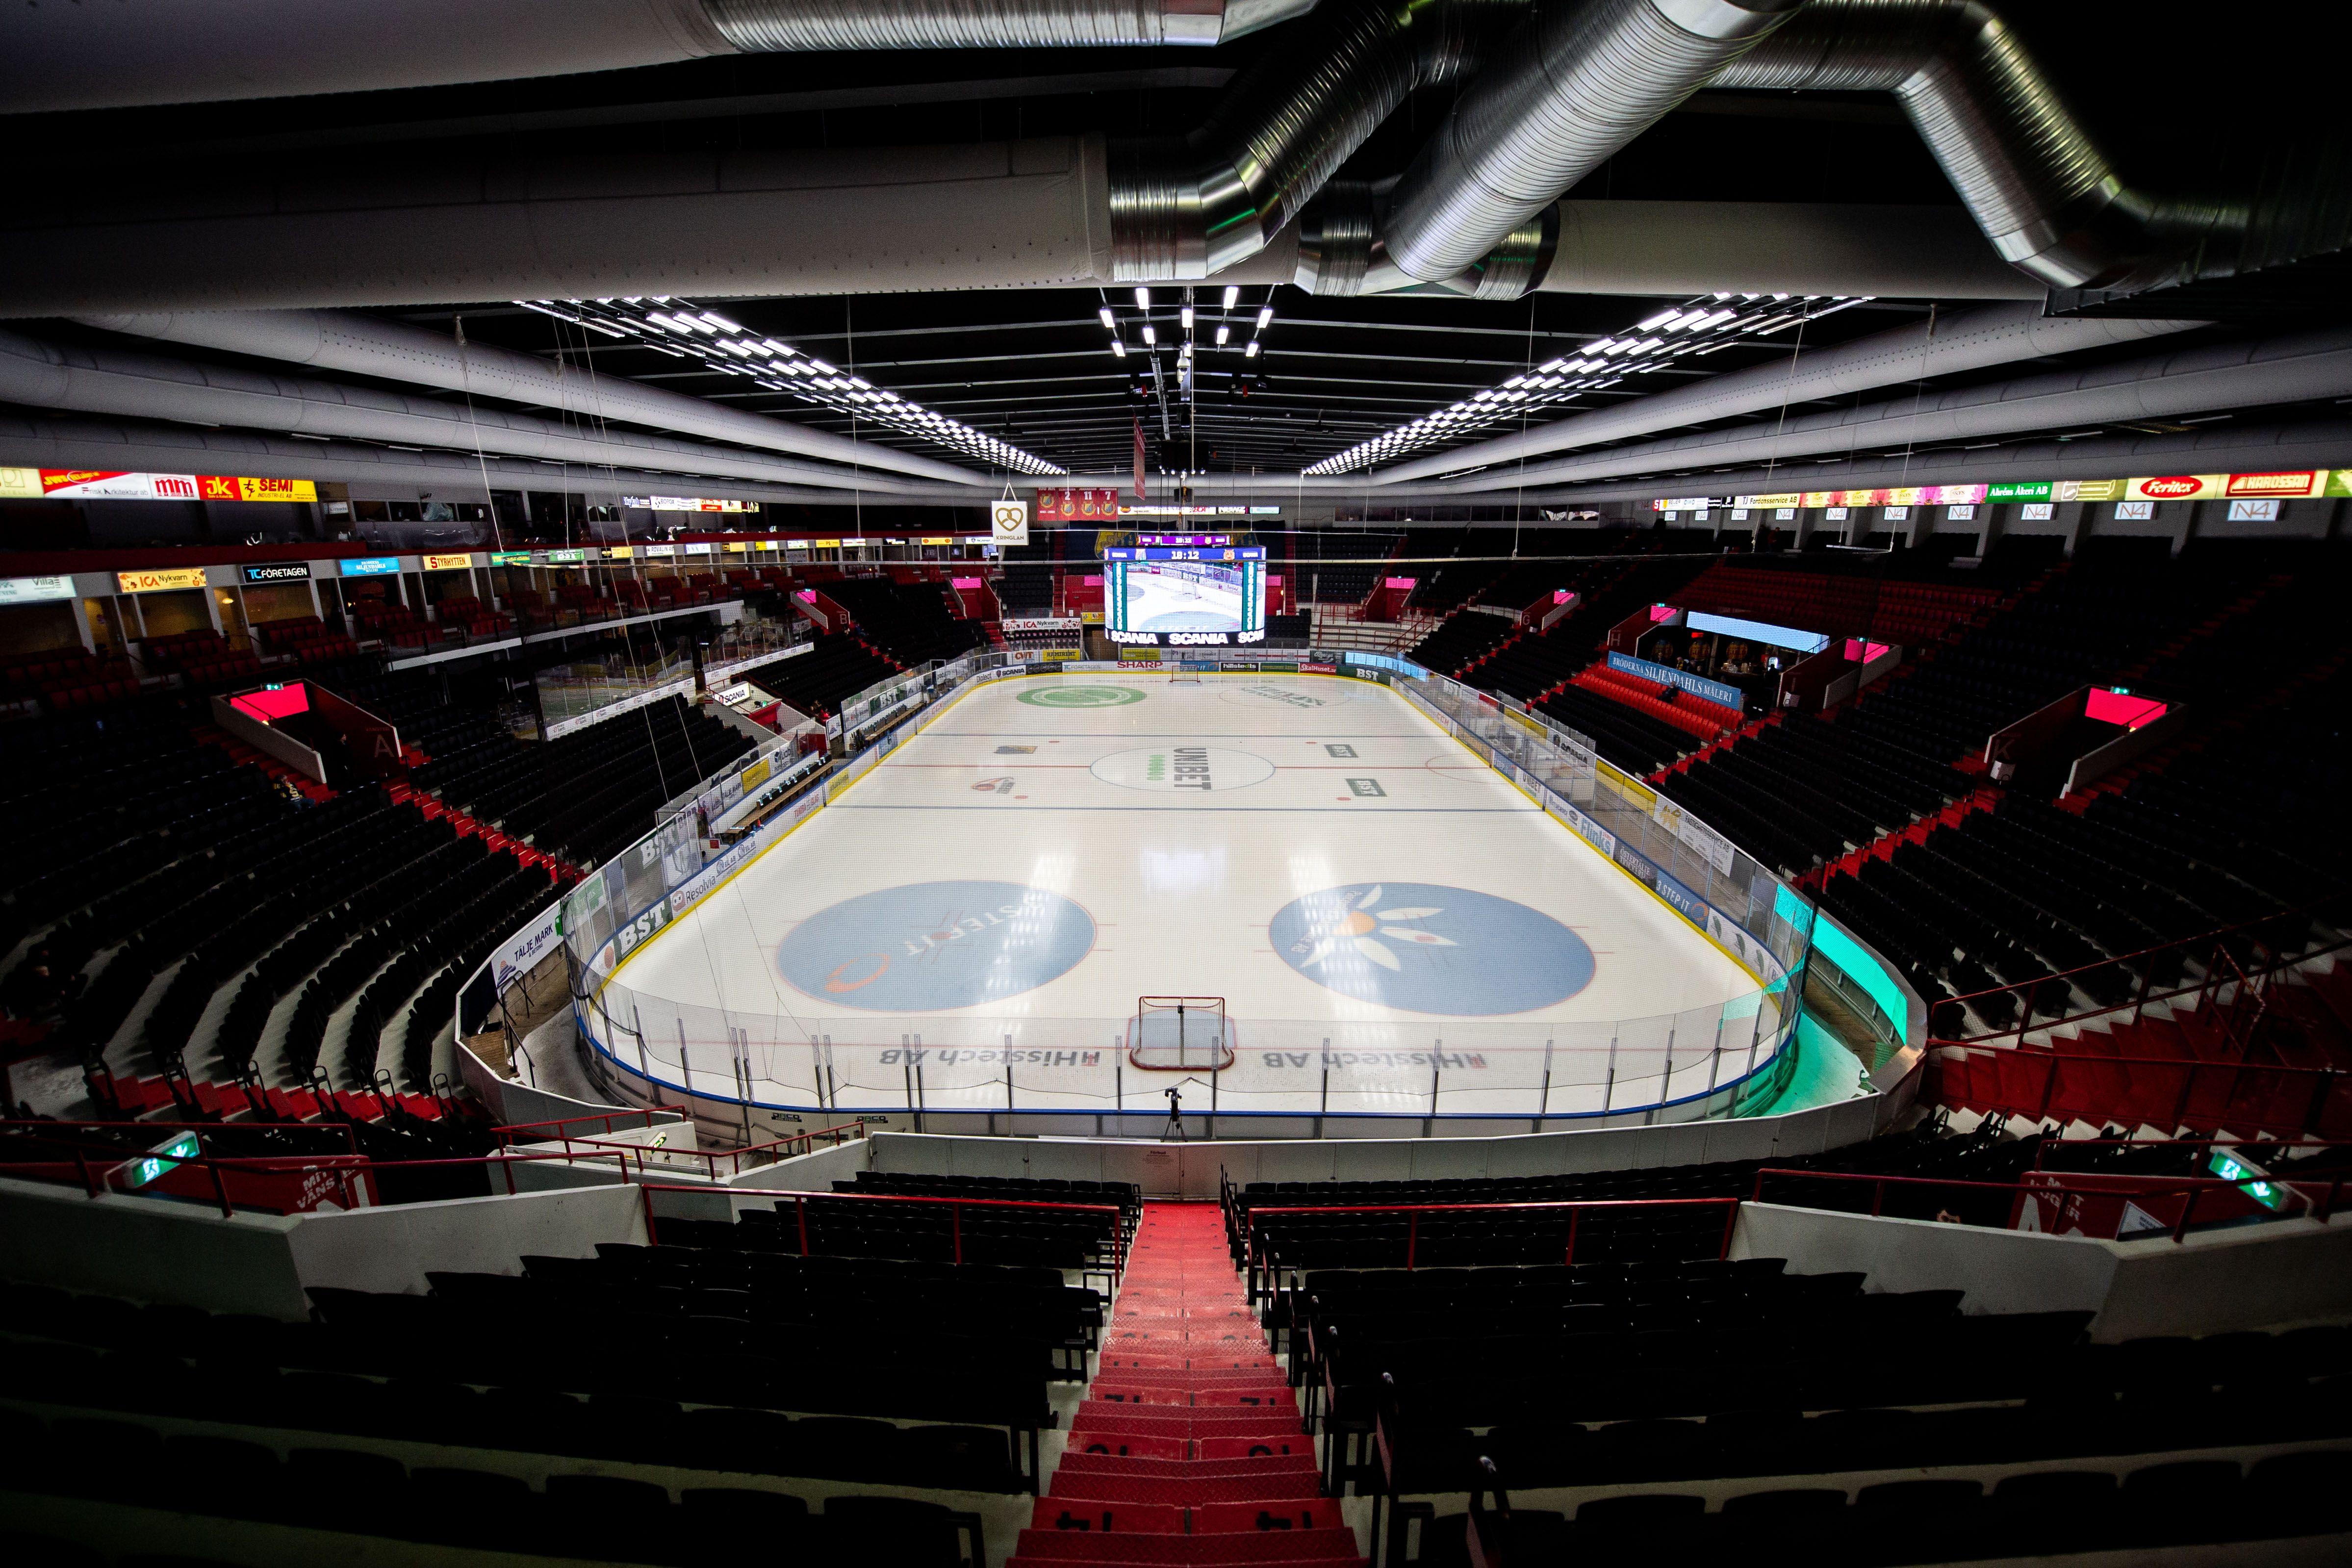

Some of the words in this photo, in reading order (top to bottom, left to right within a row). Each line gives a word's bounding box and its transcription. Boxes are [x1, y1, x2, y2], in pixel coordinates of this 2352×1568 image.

[206, 477, 232, 495] JK
[259, 479, 293, 492] SEMI
[1990, 487, 2015, 496] Ahréns
[2036, 486, 2048, 494] AB
[2147, 481, 2194, 493] Feritex
[1065, 491, 1071, 500] 2
[1084, 491, 1092, 500] 11
[1105, 491, 1111, 500] 7
[1742, 496, 1749, 505] TJ
[1733, 511, 1746, 519] N4
[1778, 510, 1791, 519] N4
[1829, 509, 1844, 519] N4
[1887, 508, 1903, 519] N4
[1950, 507, 1970, 518] N4
[2025, 506, 2048, 518] N4
[2119, 504, 2147, 518] N4
[2235, 502, 2272, 519] N4
[1171, 551, 1200, 560] 18:12
[430, 556, 466, 569] STYRHYTTEN
[261, 567, 307, 579] FÖRETAGEN
[139, 575, 160, 588] ICA
[158, 574, 188, 584] Nykvarn
[1023, 620, 1038, 629] ICA
[1111, 630, 1158, 644] SCANIA
[1168, 632, 1229, 645] SCANIA
[1002, 668, 1025, 676] SCANIA
[1356, 668, 1379, 682] BST
[1612, 656, 1644, 674] BRÖDERNA
[1644, 660, 1703, 695] SILJENDAHLS
[1703, 685, 1733, 703] MÅLERI
[725, 689, 745, 703] SCANIA
[879, 688, 898, 707] BST
[1174, 747, 1212, 791] UNIBET
[685, 875, 716, 904] Resolvia
[1656, 879, 1663, 893] 3
[1662, 885, 1681, 905] STEP
[1681, 898, 1690, 912] IT
[618, 900, 667, 955] BST
[514, 939, 534, 962] TÄLJE
[534, 922, 554, 945] MARK
[531, 942, 544, 956] BETONG
